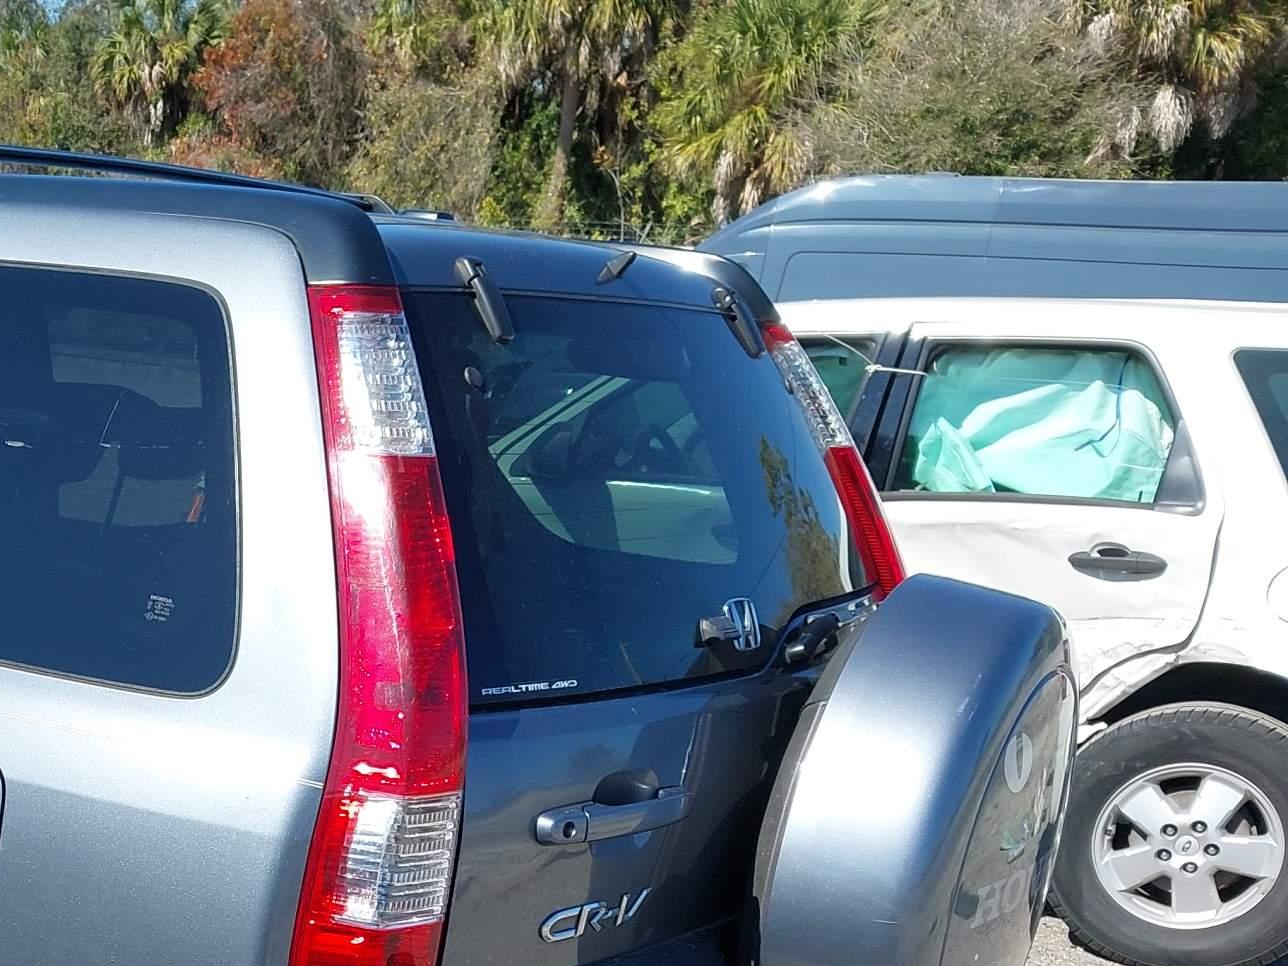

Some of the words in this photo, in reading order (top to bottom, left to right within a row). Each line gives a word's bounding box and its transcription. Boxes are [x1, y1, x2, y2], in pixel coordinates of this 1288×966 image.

[481, 682, 550, 696] REALTIME
[551, 679, 578, 689] 4WD
[538, 887, 652, 943] CR-V
